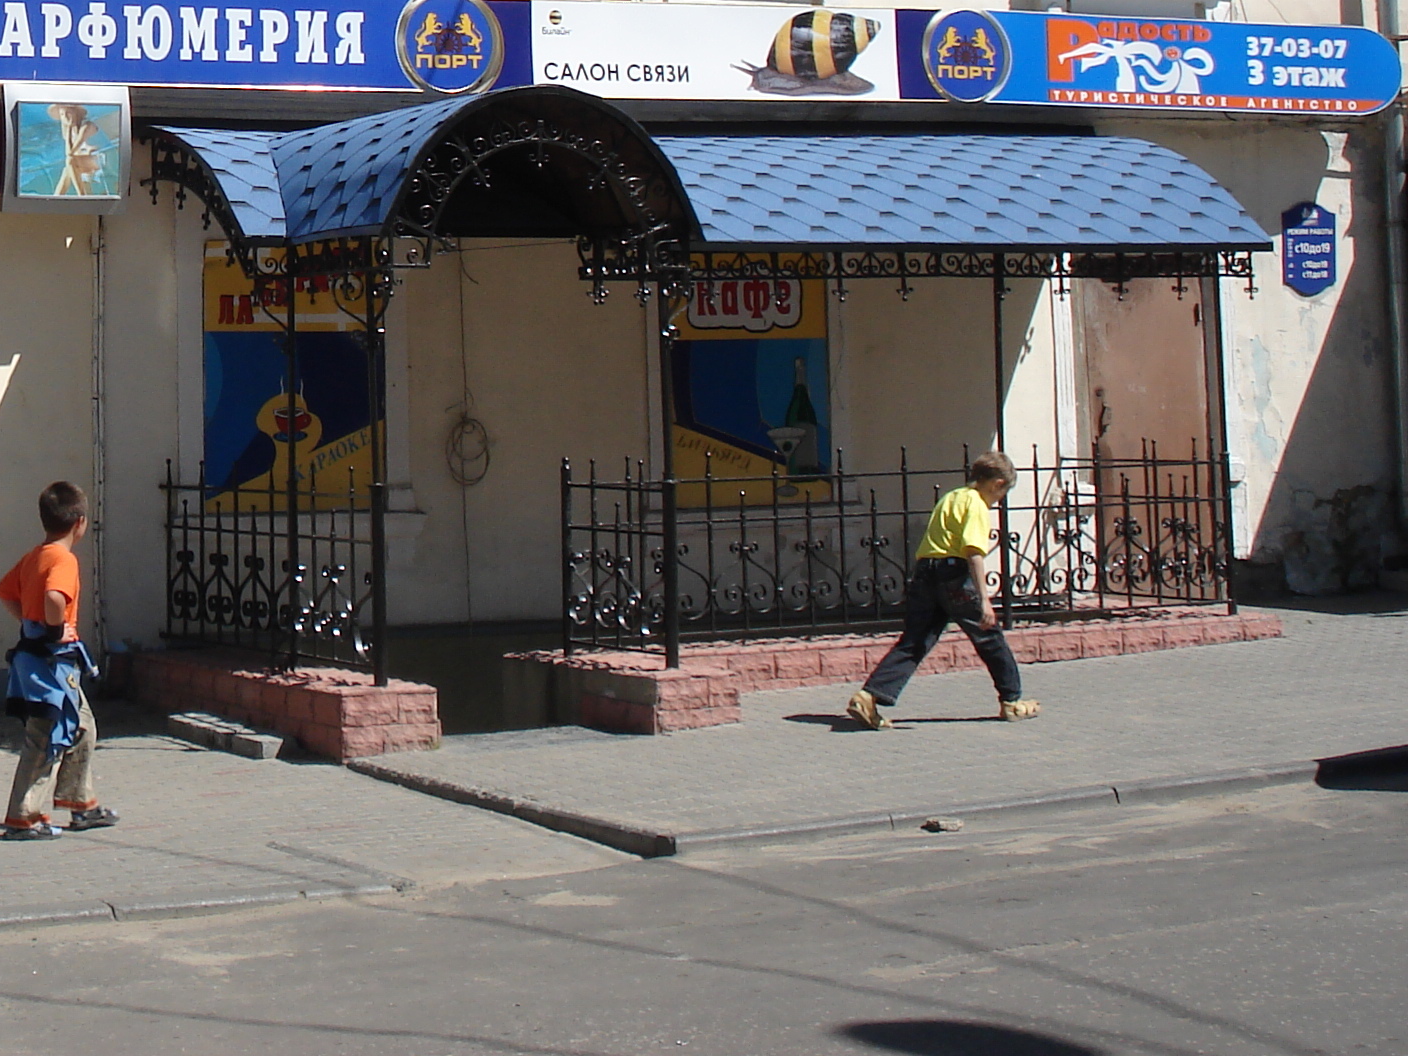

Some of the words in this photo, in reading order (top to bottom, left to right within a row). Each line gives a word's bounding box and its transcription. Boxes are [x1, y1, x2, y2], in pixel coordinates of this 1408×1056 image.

[1246, 36, 1348, 59] 37-03-07
[416, 54, 483, 69] ПОРТ
[544, 62, 619, 81] САЛОН
[627, 64, 690, 83] СВЯЗИ
[937, 64, 996, 81] ПОРТ
[1247, 59, 1265, 86] 3
[1273, 66, 1347, 88] этаж
[1053, 90, 1228, 107] ТУРИСТИЧЕСКОЕ
[1247, 97, 1358, 111] АГЕНТСТВО
